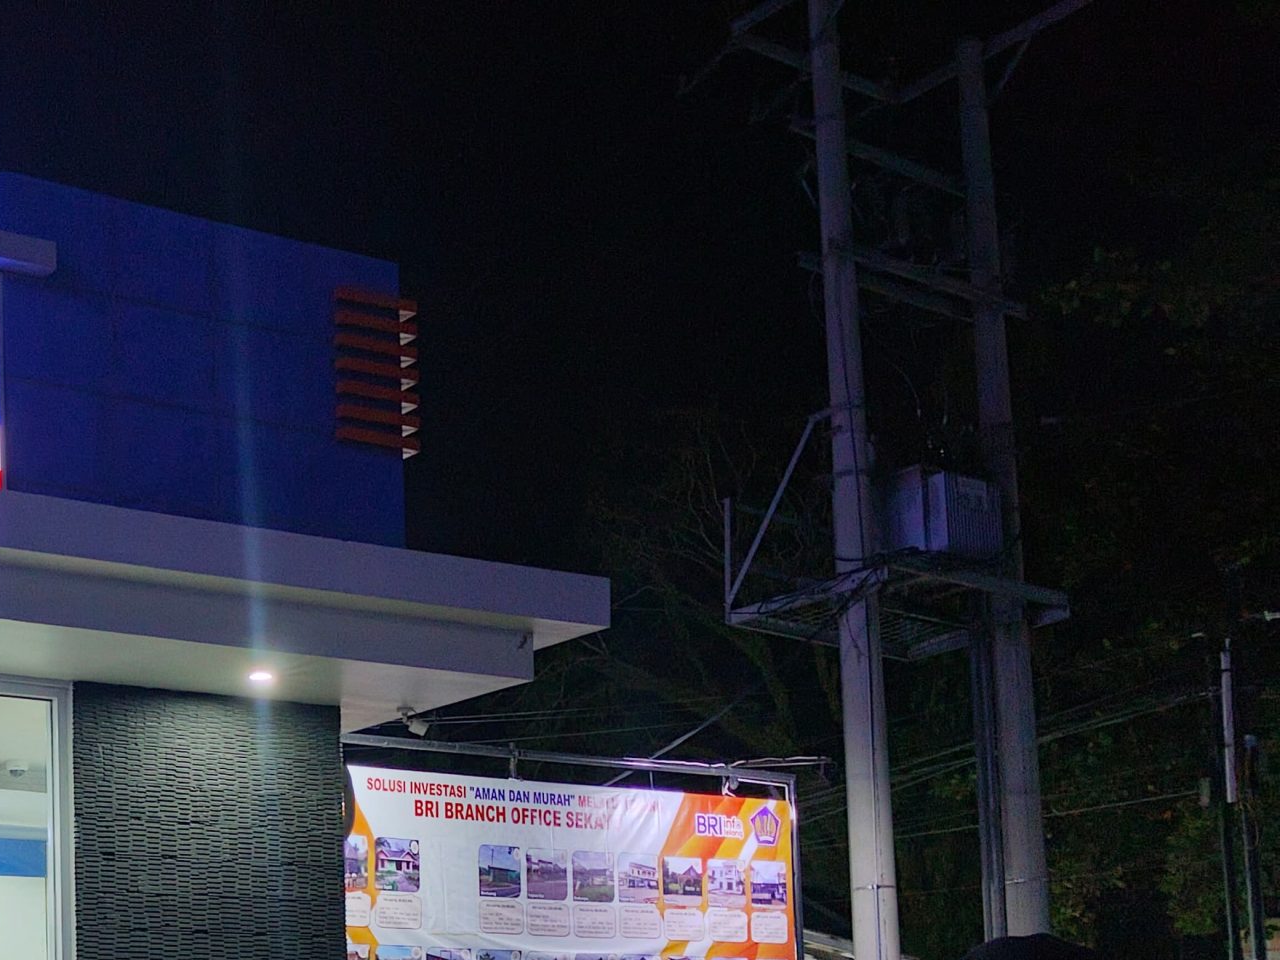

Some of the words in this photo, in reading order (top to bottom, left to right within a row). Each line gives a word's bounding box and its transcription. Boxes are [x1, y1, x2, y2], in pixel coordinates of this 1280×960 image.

[367, 777, 406, 793] SOLUSI
[410, 781, 467, 799] INVESTASI
[470, 786, 505, 801] "AMAN
[509, 789, 529, 803] DAN
[533, 792, 575, 807] MURAH"
[414, 799, 439, 818] BRI
[444, 802, 506, 823] BRANCH
[511, 806, 561, 828] OFFICE
[696, 815, 722, 835] BRI
